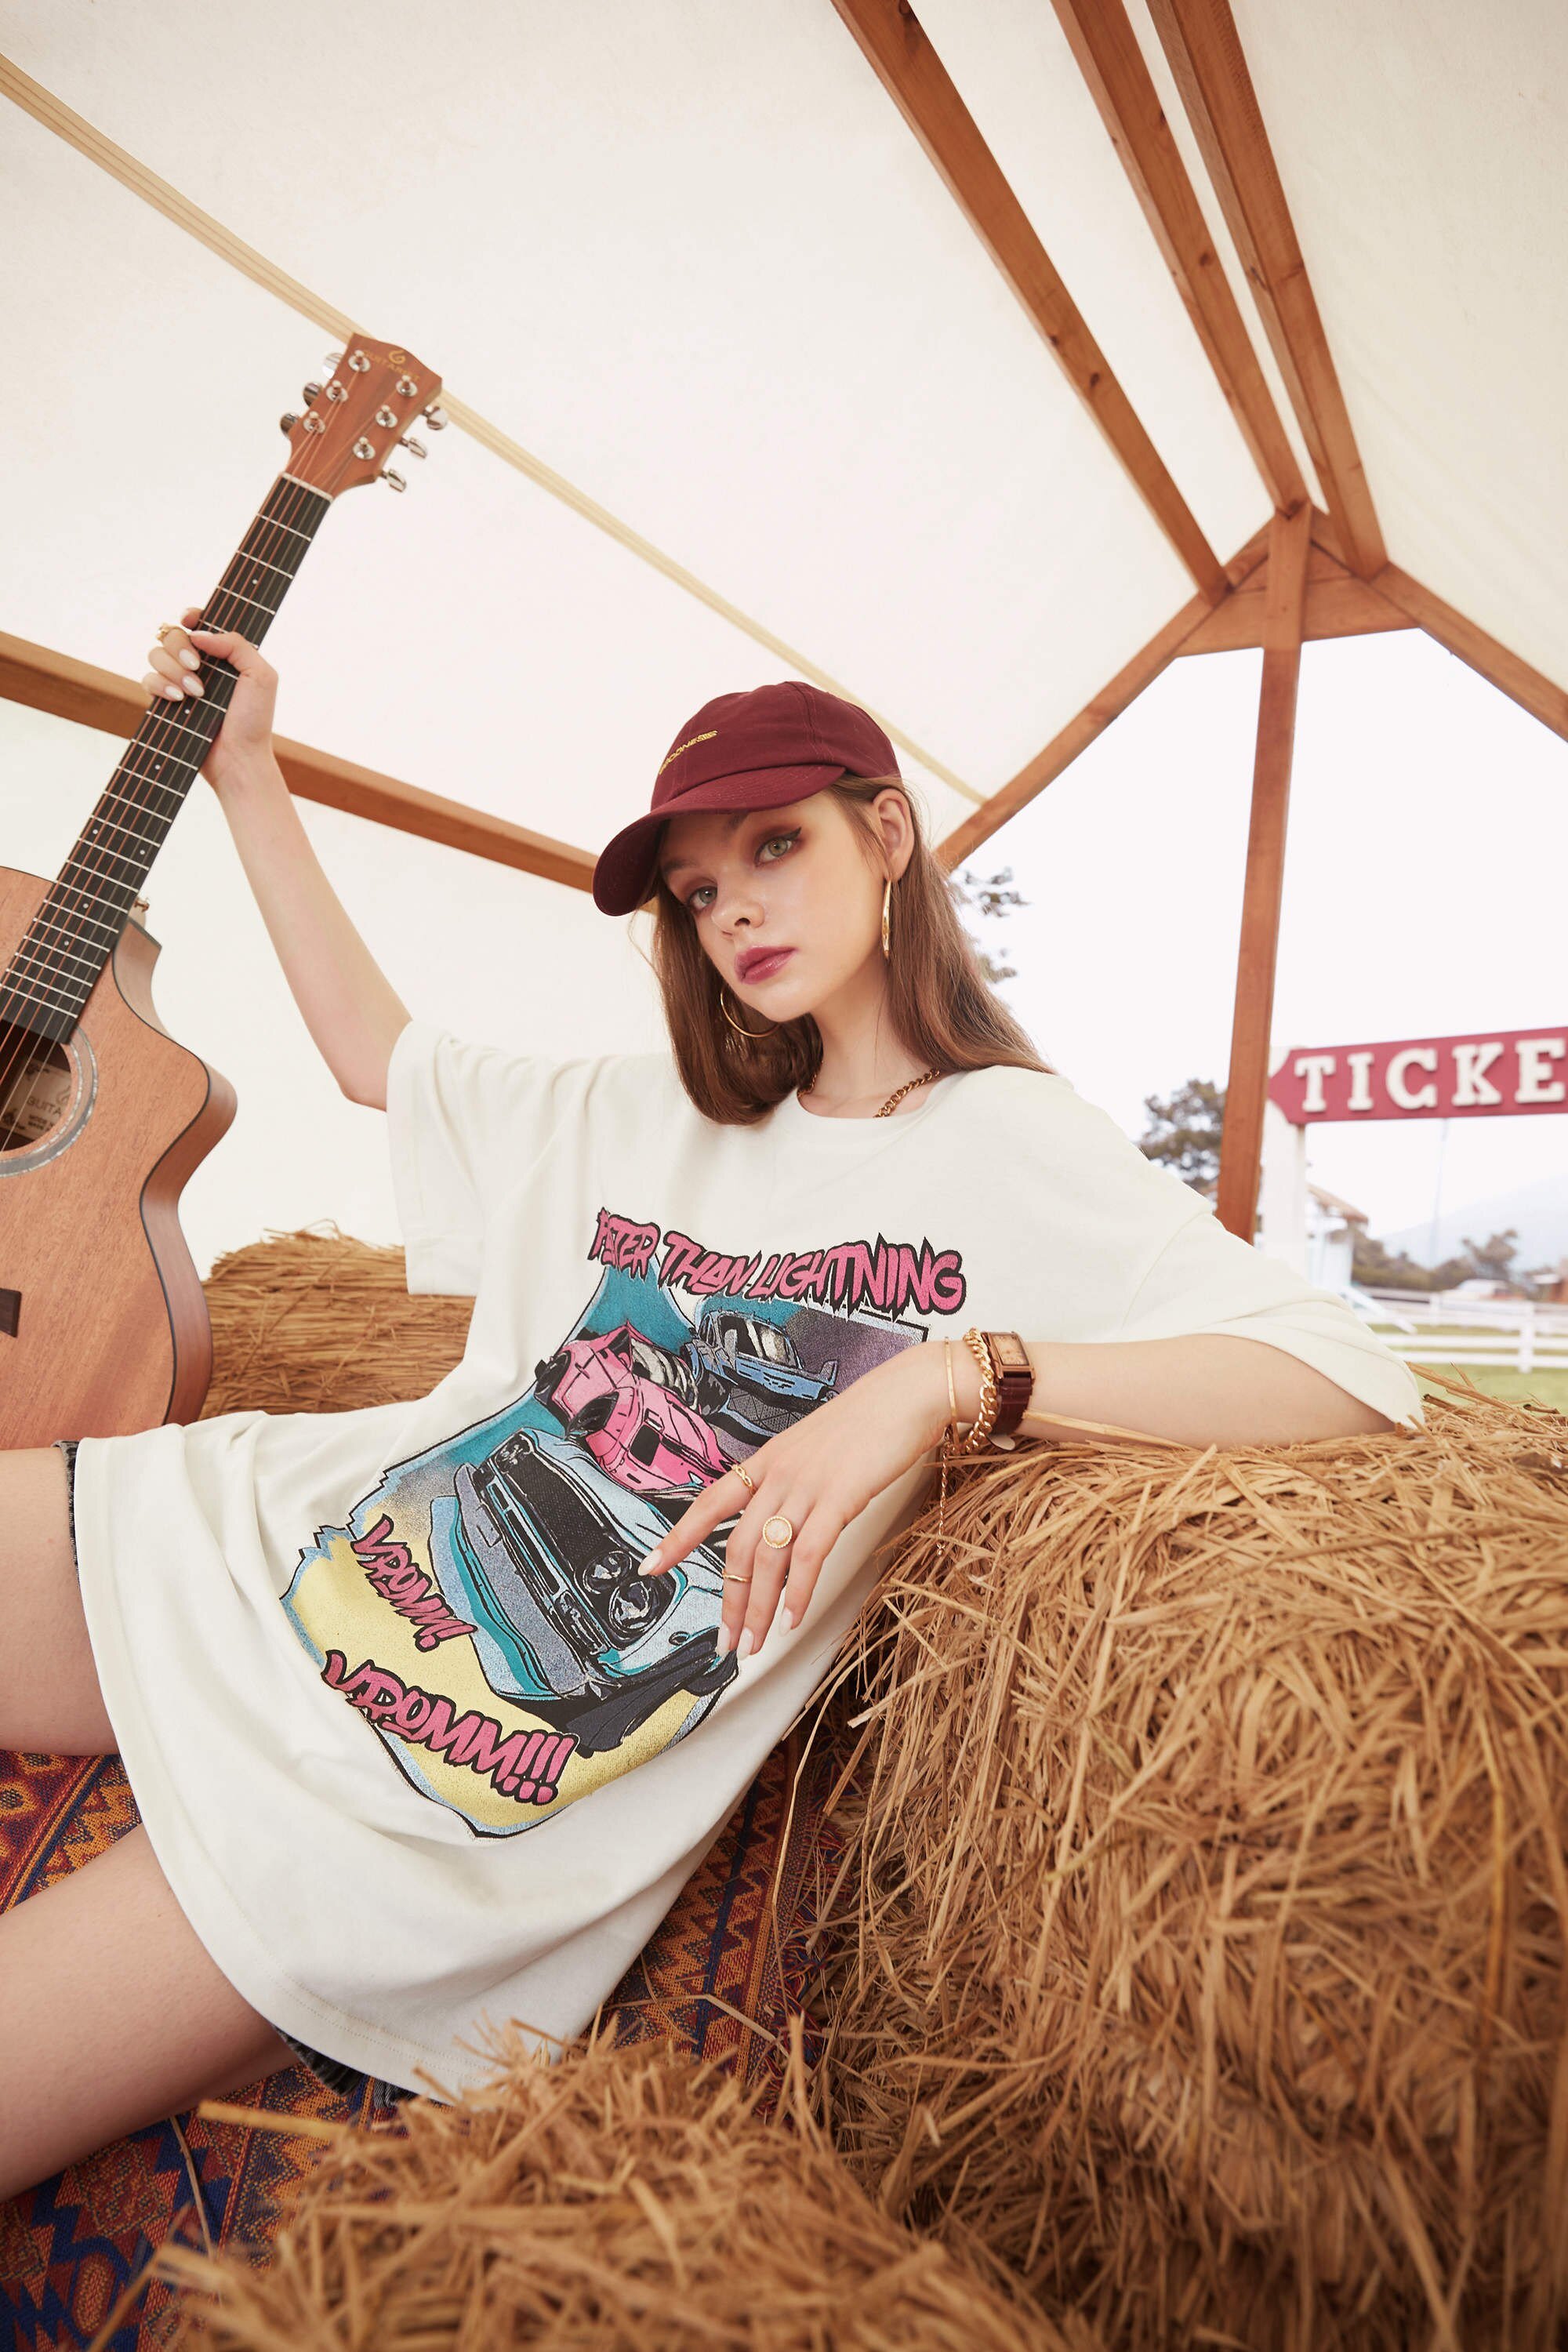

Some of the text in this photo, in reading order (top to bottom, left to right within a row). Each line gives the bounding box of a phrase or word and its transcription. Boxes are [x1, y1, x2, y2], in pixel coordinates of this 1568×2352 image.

[1294, 1037, 1566, 1113] TICKE
[659, 1230, 762, 1298] THAN
[745, 1232, 967, 1321] LIGHTNING
